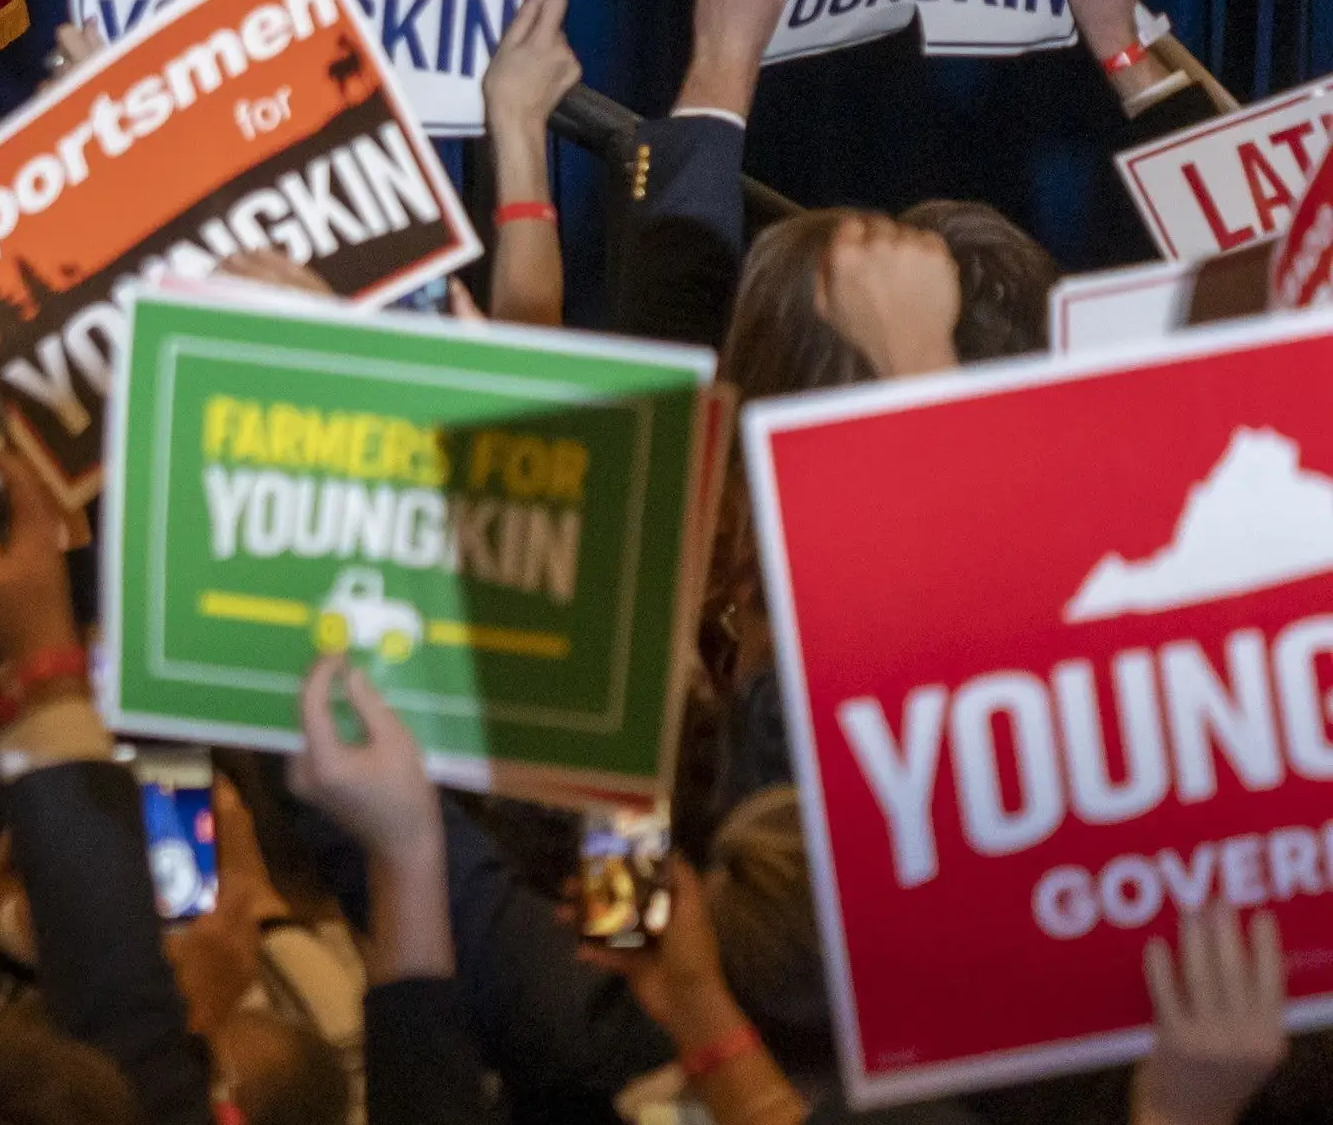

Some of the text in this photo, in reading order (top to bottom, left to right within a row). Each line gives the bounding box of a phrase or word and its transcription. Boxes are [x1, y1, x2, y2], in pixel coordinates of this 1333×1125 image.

[233, 83, 293, 142] for
[1180, 113, 1333, 251] LAT
[202, 394, 588, 502] FARMERS FOR
[201, 464, 582, 605] YOUNGKIN
